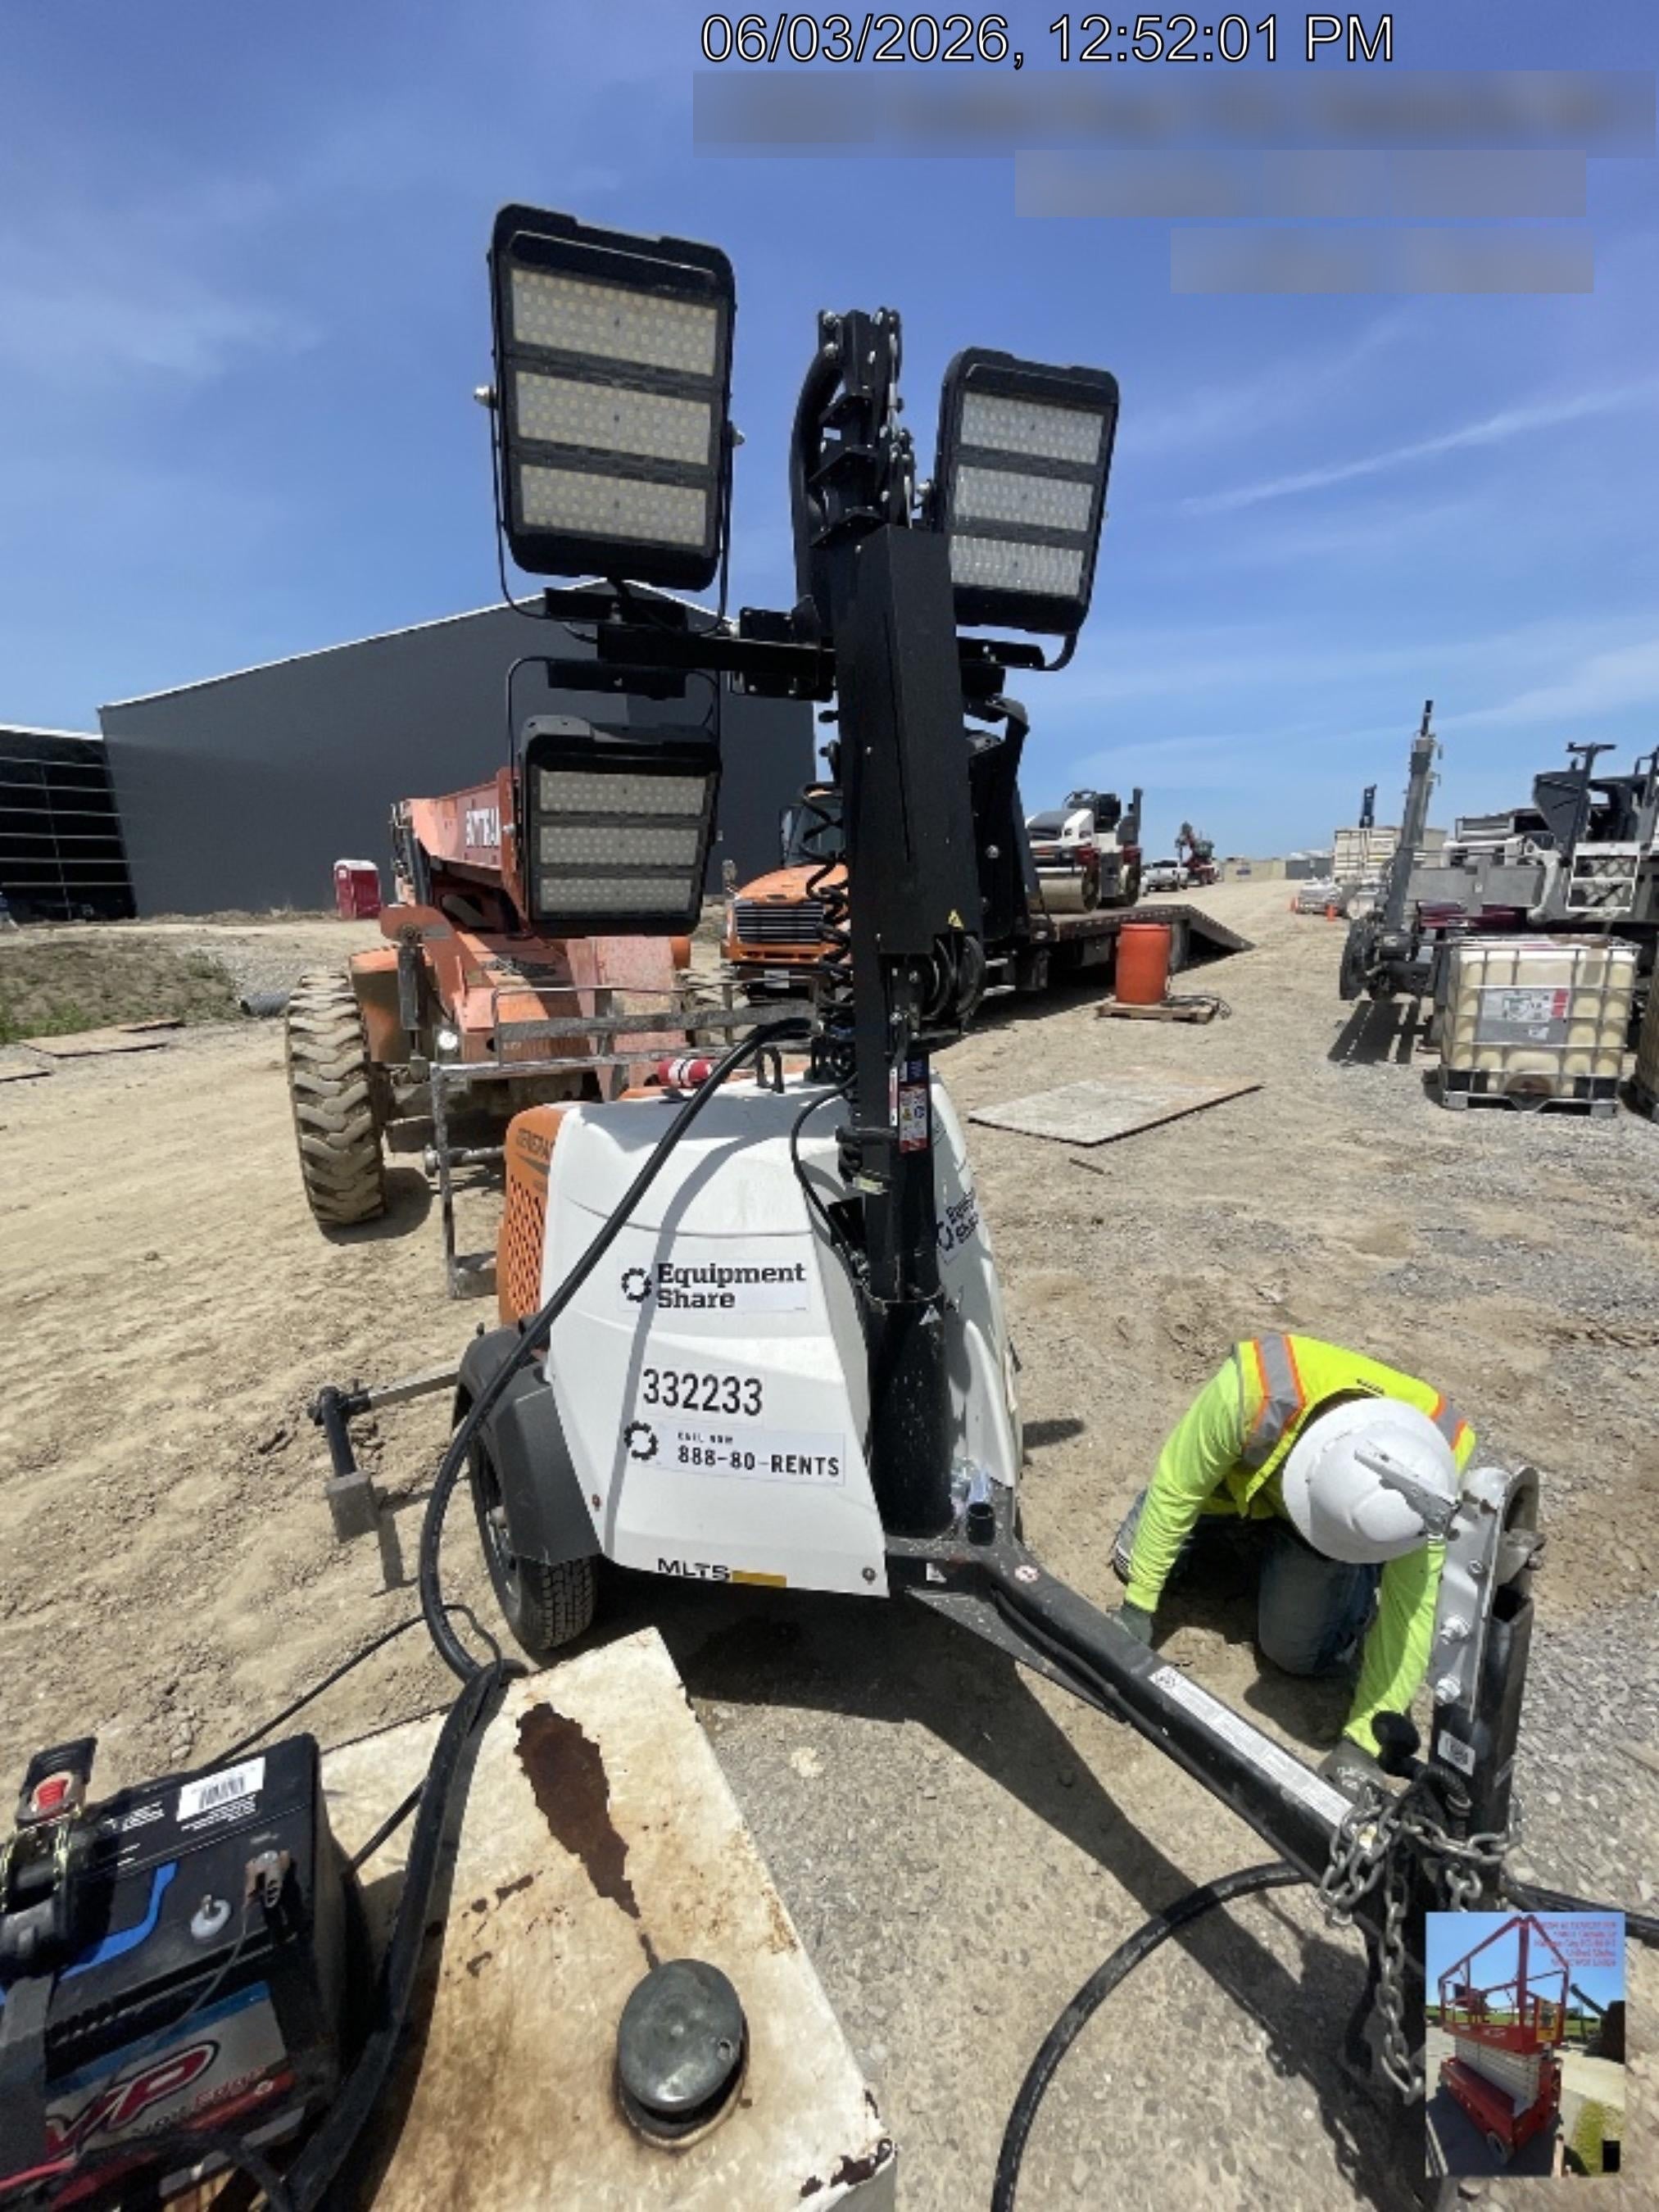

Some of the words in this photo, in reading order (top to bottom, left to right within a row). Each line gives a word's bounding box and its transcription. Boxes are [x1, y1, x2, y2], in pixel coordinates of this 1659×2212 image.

[657, 1262, 807, 1289] Equipment
[657, 1288, 737, 1309] Share
[642, 1368, 764, 1416] 332233
[677, 1444, 841, 1476] 888-80-RENTS
